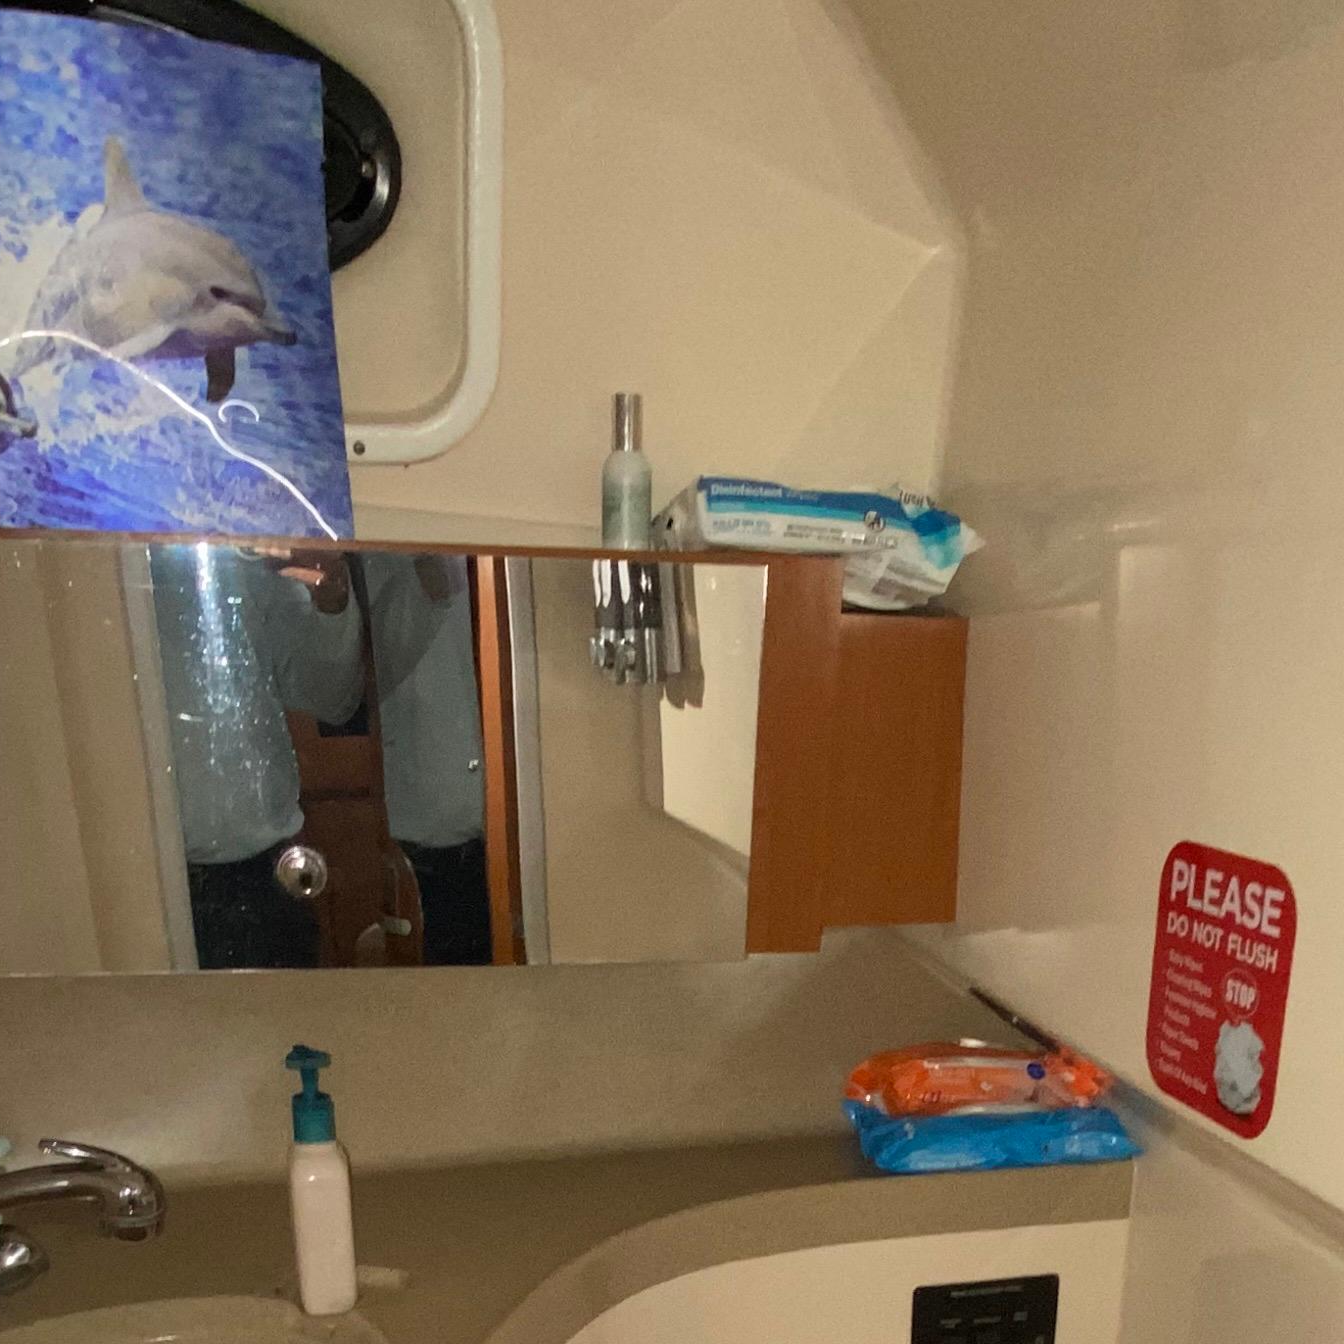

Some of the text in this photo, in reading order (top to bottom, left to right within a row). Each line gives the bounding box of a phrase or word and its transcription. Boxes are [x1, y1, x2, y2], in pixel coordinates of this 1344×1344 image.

[1169, 857, 1286, 940] PLEASE
[1166, 911, 1190, 939] DO
[1191, 918, 1225, 952] NOT
[1226, 932, 1279, 974] FLUSH
[1224, 978, 1256, 1010] STOP
